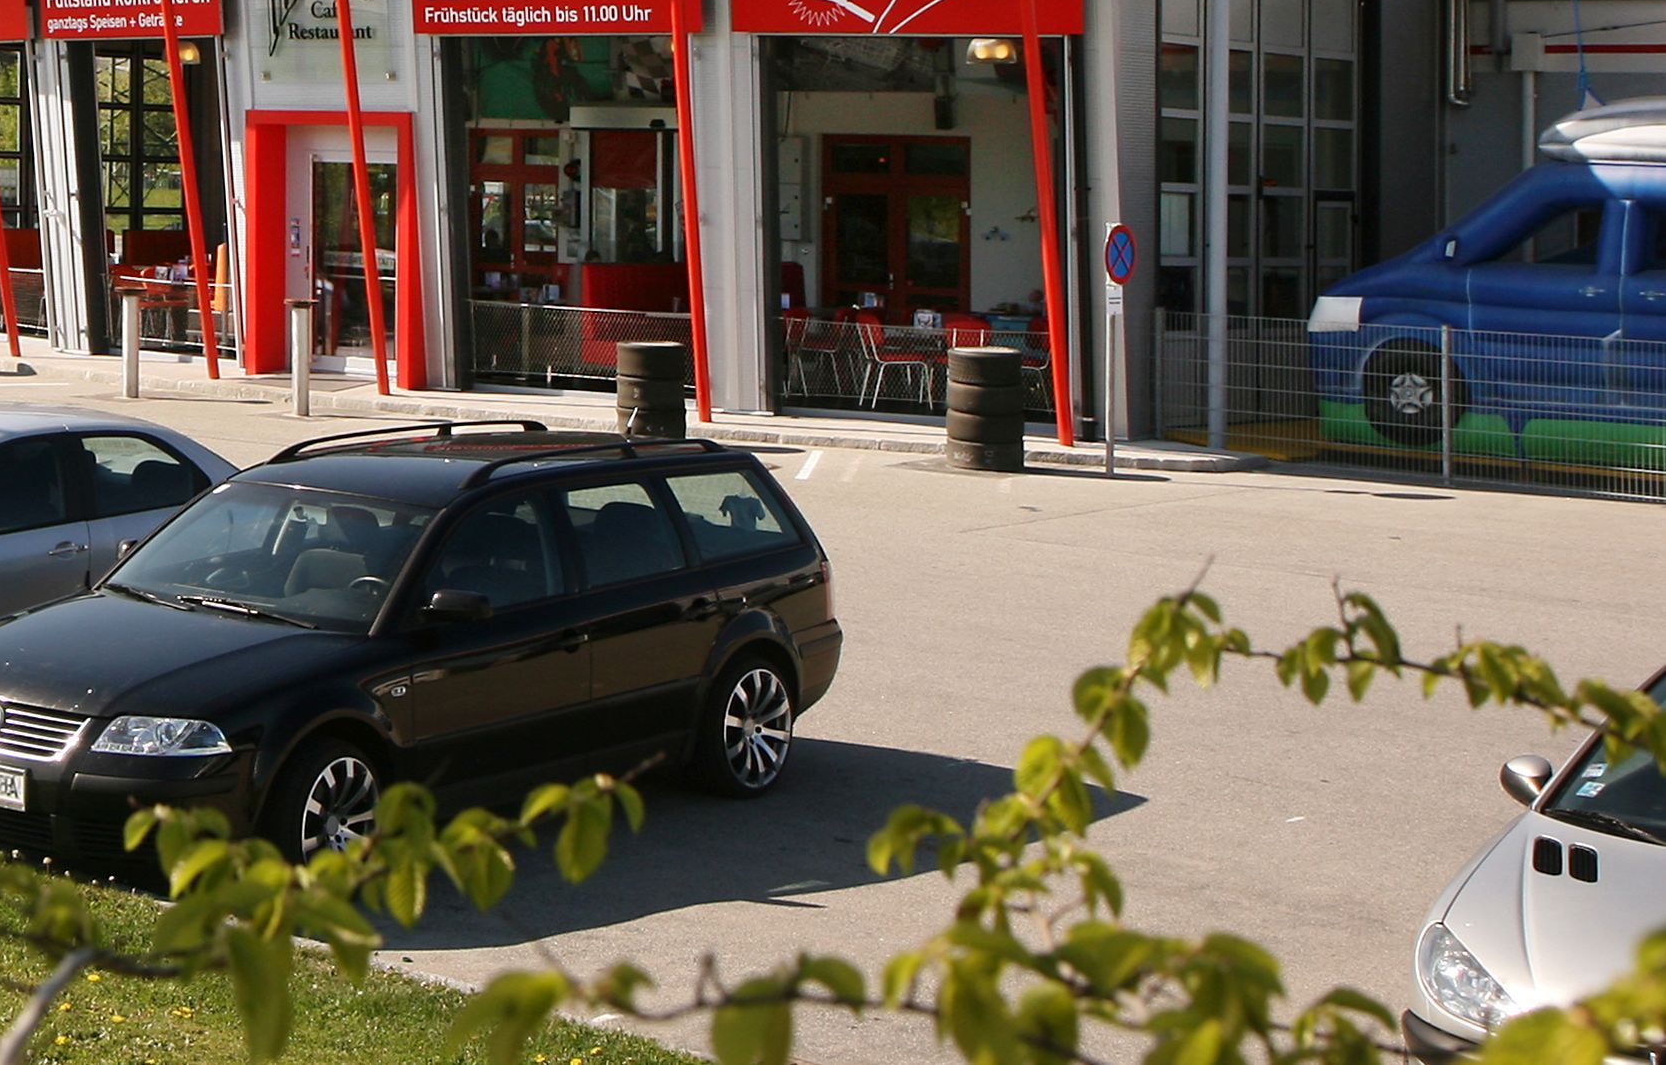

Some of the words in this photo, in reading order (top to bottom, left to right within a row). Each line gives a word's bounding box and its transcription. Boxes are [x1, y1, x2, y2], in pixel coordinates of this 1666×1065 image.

[310, 0, 339, 19] Caf
[424, 6, 498, 24] Frühstück
[502, 5, 550, 27] täglich
[555, 6, 578, 23] bis
[583, 5, 618, 22] 11.00
[622, 5, 651, 22] Uhr
[47, 15, 88, 34] ganztags
[89, 14, 127, 31] Speisen
[138, 12, 183, 28] Geträe
[288, 22, 373, 40] Restaunt
